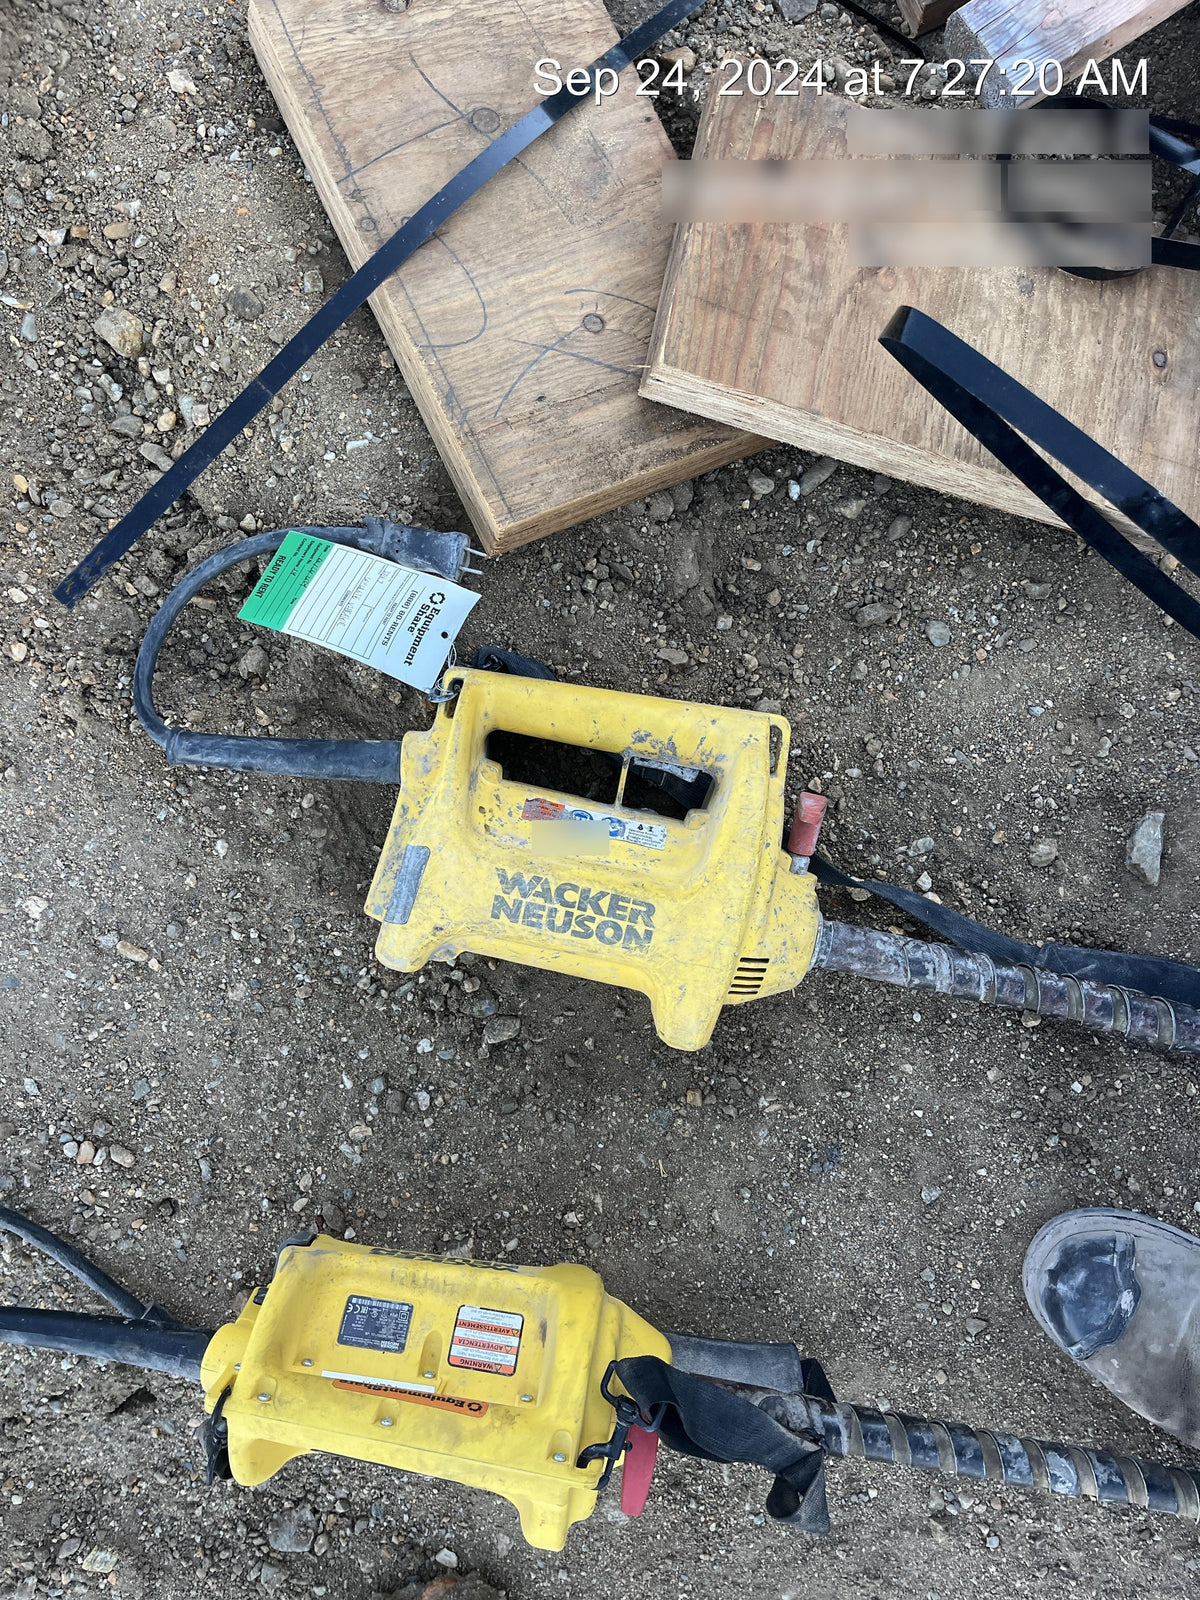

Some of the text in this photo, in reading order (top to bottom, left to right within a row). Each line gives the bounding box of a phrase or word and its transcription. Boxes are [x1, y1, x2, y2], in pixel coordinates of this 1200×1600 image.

[254, 554, 286, 598] READY TO RENT
[402, 605, 441, 667] Equipment
[406, 602, 430, 633] Share
[495, 867, 656, 928] WACKER
[491, 894, 655, 952] NEUSON
[458, 1320, 511, 1334] AVERTISSEMENT
[458, 1338, 504, 1351] ADVERTENCIA
[460, 1358, 494, 1370] WARNING
